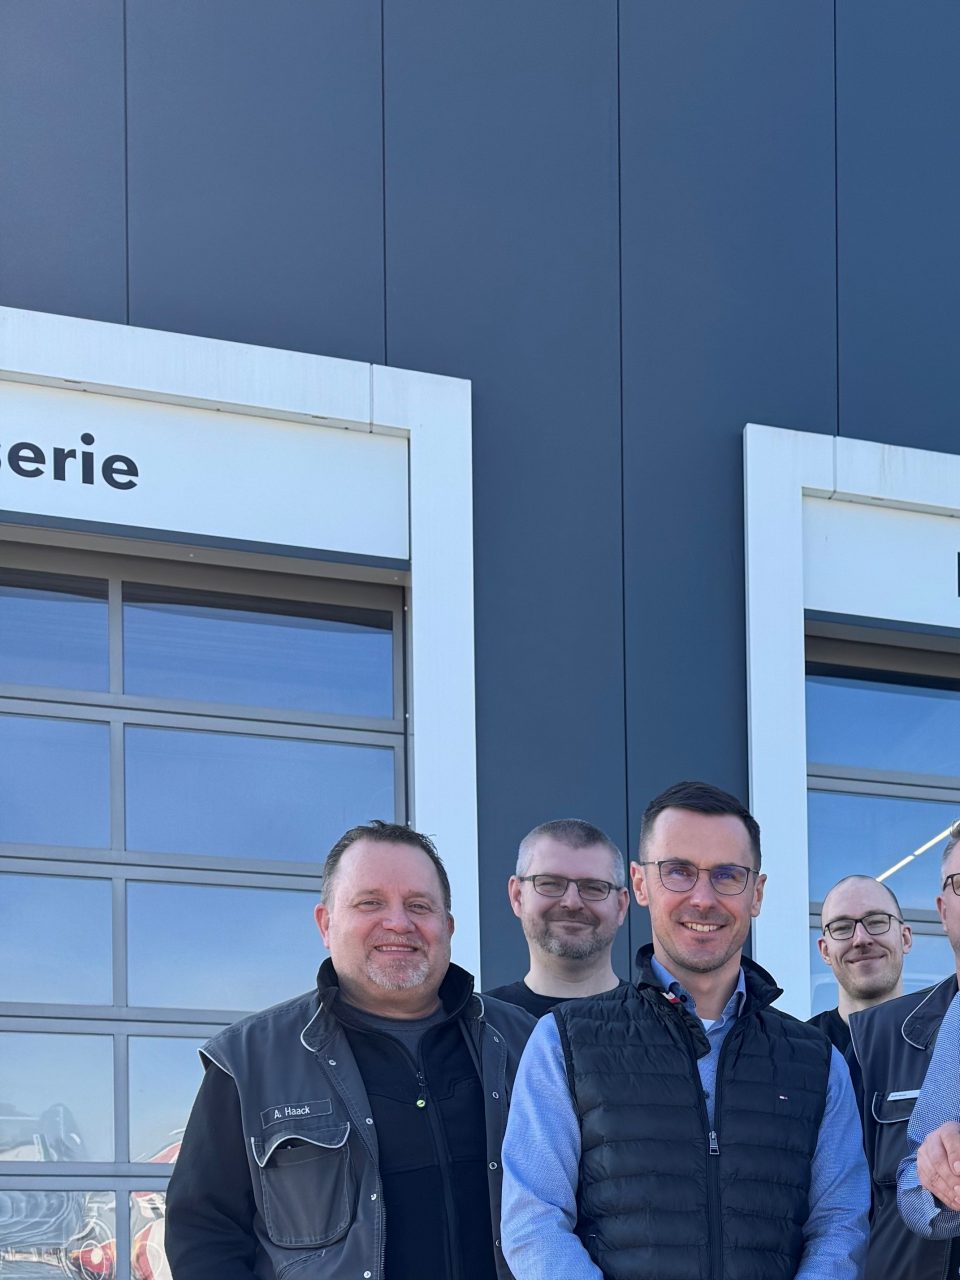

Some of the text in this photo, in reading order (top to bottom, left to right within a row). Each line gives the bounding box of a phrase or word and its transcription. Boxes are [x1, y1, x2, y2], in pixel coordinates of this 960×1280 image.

[0, 432, 139, 491] erie
[274, 1105, 311, 1119] A. Haack
